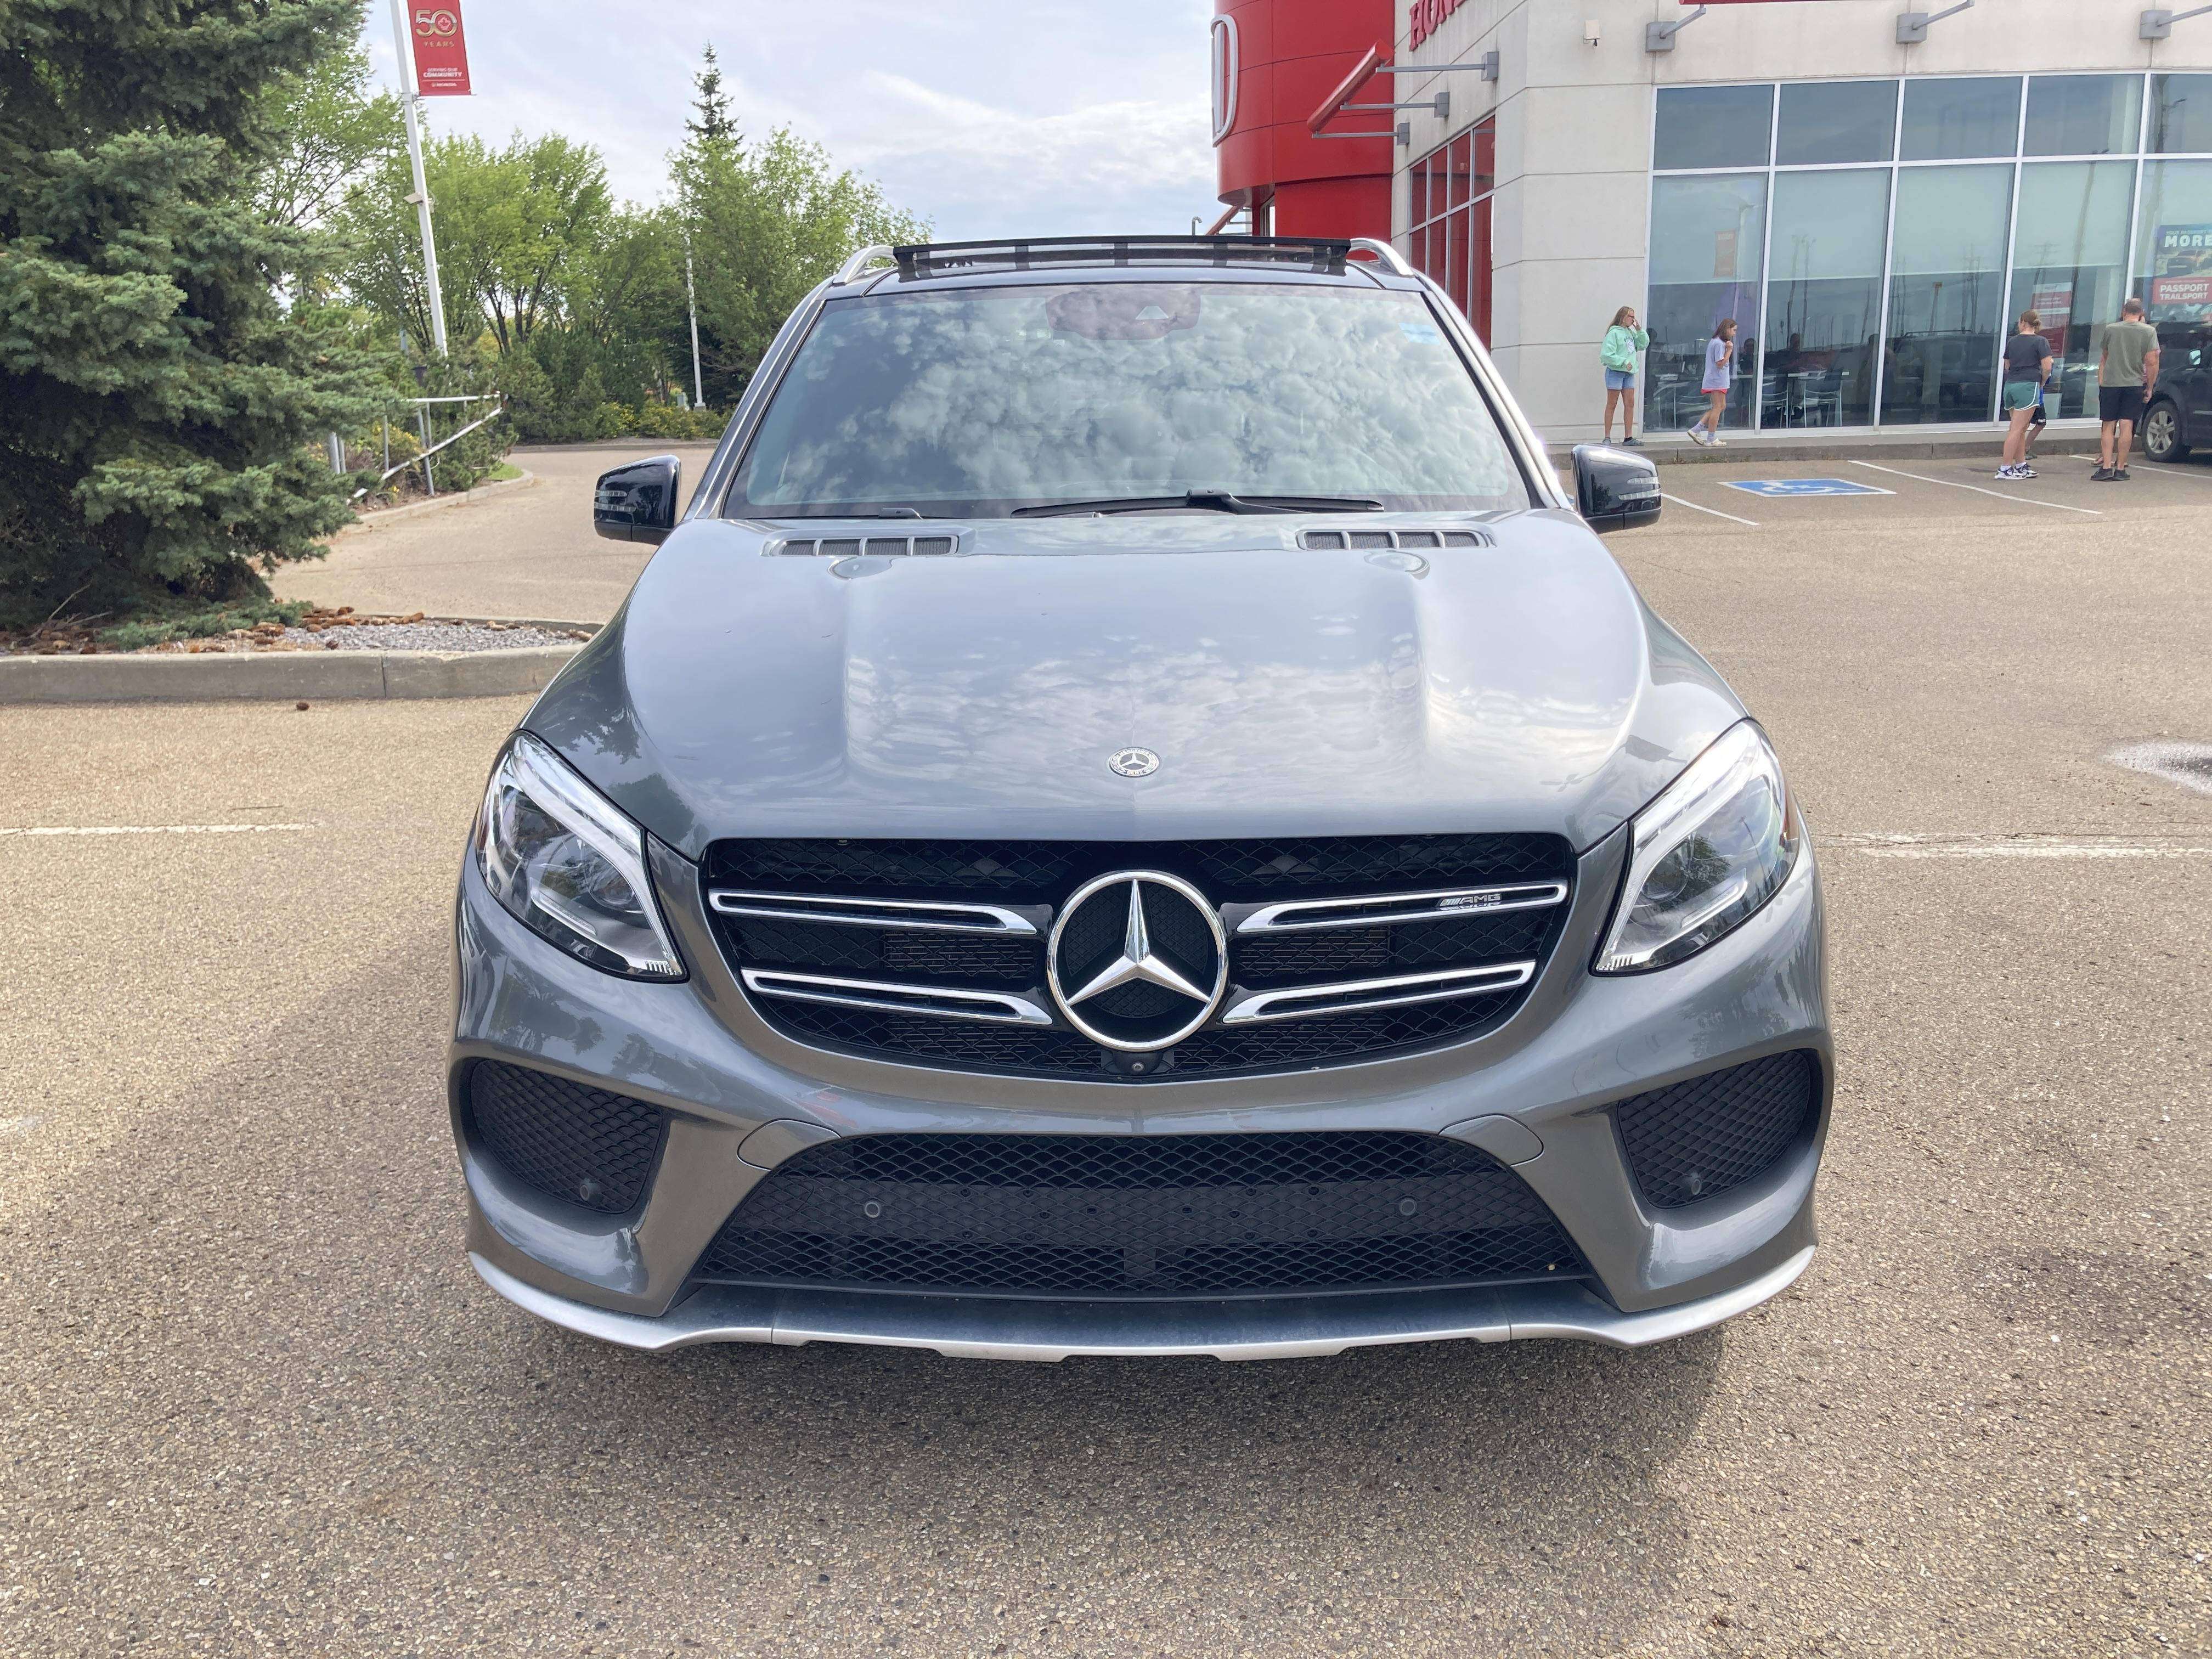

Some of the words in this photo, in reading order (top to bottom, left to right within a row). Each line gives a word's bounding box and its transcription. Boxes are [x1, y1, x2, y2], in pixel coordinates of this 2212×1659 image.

[416, 9, 457, 37] 50
[2164, 234, 2212, 247] MORE
[2160, 283, 2210, 292] PASSPORT
[2159, 292, 2208, 300] TRAILSPORT
[1459, 894, 1501, 905] AMG
